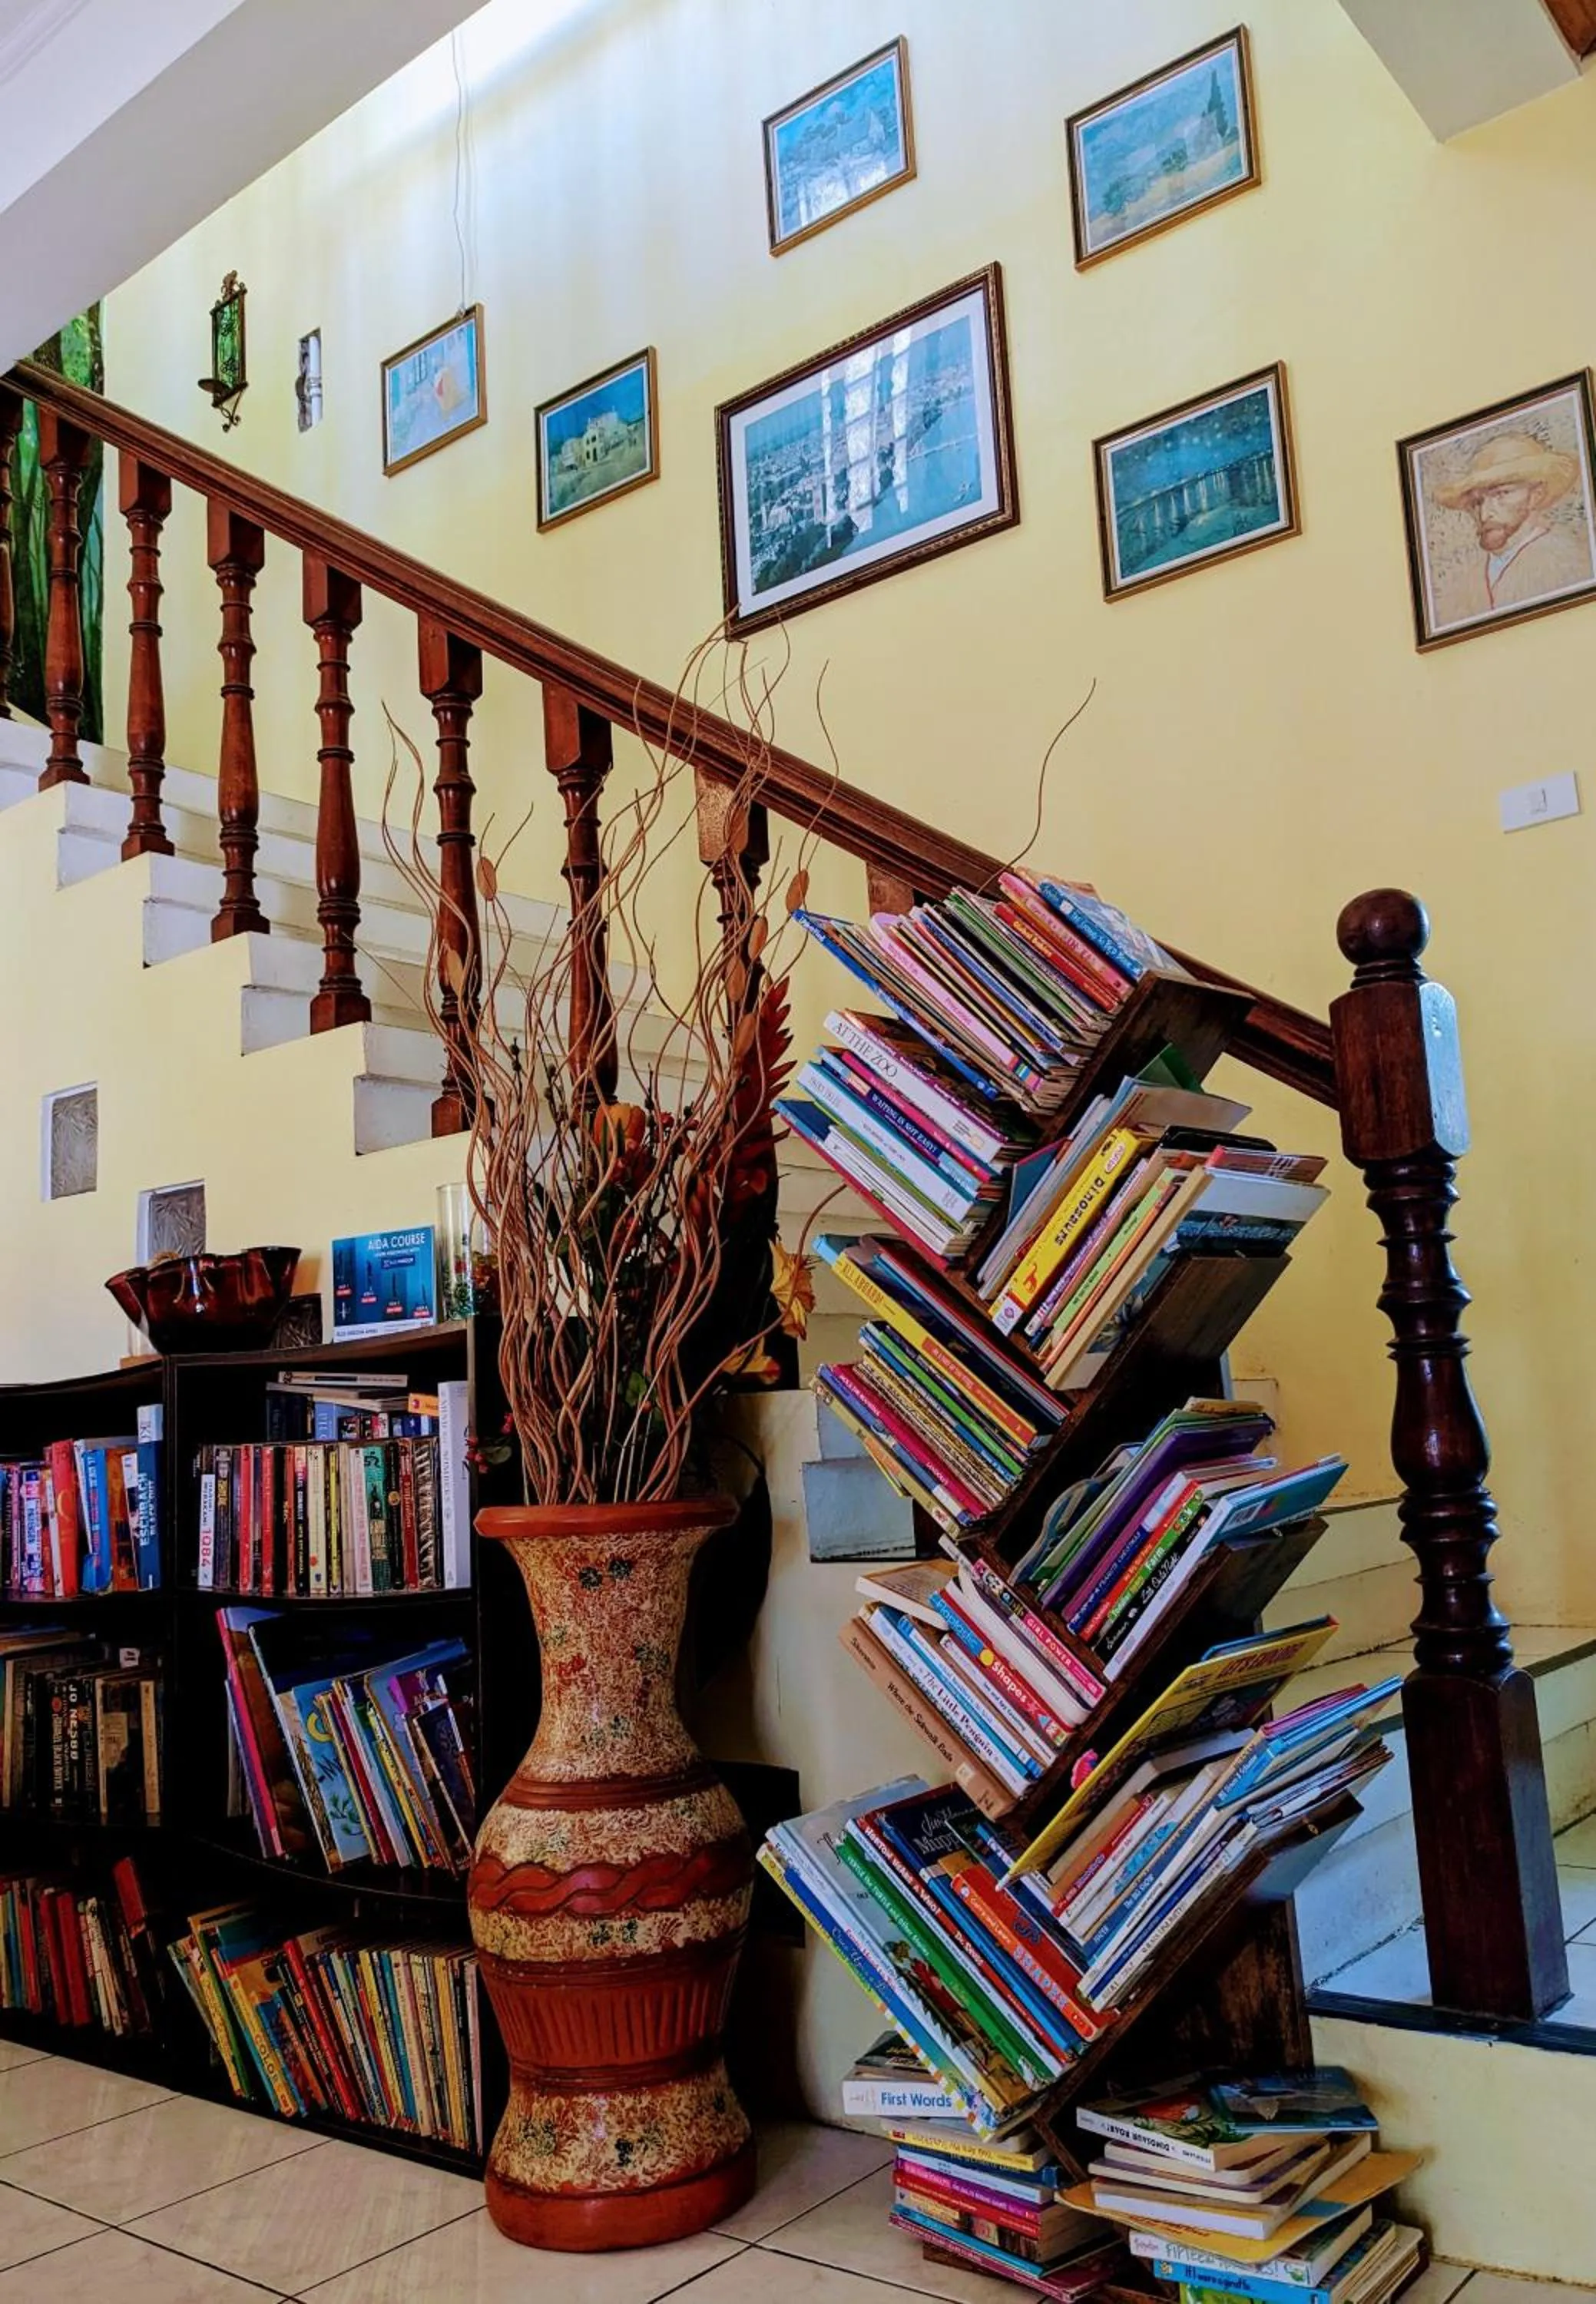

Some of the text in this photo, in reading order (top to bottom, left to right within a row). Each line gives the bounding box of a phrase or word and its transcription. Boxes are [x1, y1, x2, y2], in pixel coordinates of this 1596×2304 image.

[832, 1021, 899, 1079] AT THE ZOO
[869, 1094, 899, 1121] WAITING
[896, 1116, 906, 1126] IS
[902, 1122, 919, 1137] NOT
[916, 1133, 938, 1154] EASY!
[369, 1233, 425, 1250] AIDA COURSE
[139, 1472, 151, 1547] ESCHBACH
[200, 1528, 211, 1567] 1Q84
[1144, 1544, 1166, 1571] Farm
[1023, 1617, 1075, 1667] GIRL POWER
[68, 1684, 78, 1702] JO
[987, 1659, 1031, 1704] Shapes
[884, 1681, 908, 1706] Where
[902, 1703, 917, 1717] the
[935, 1741, 956, 1763] Ends
[921, 1670, 998, 1758] The Little Penguin
[863, 1824, 894, 1862] HORTON
[952, 1929, 985, 1968] Dr. Seuss
[881, 2093, 952, 2107] First Words
[1105, 2124, 1171, 2151] DINOSAUR ROAR!
